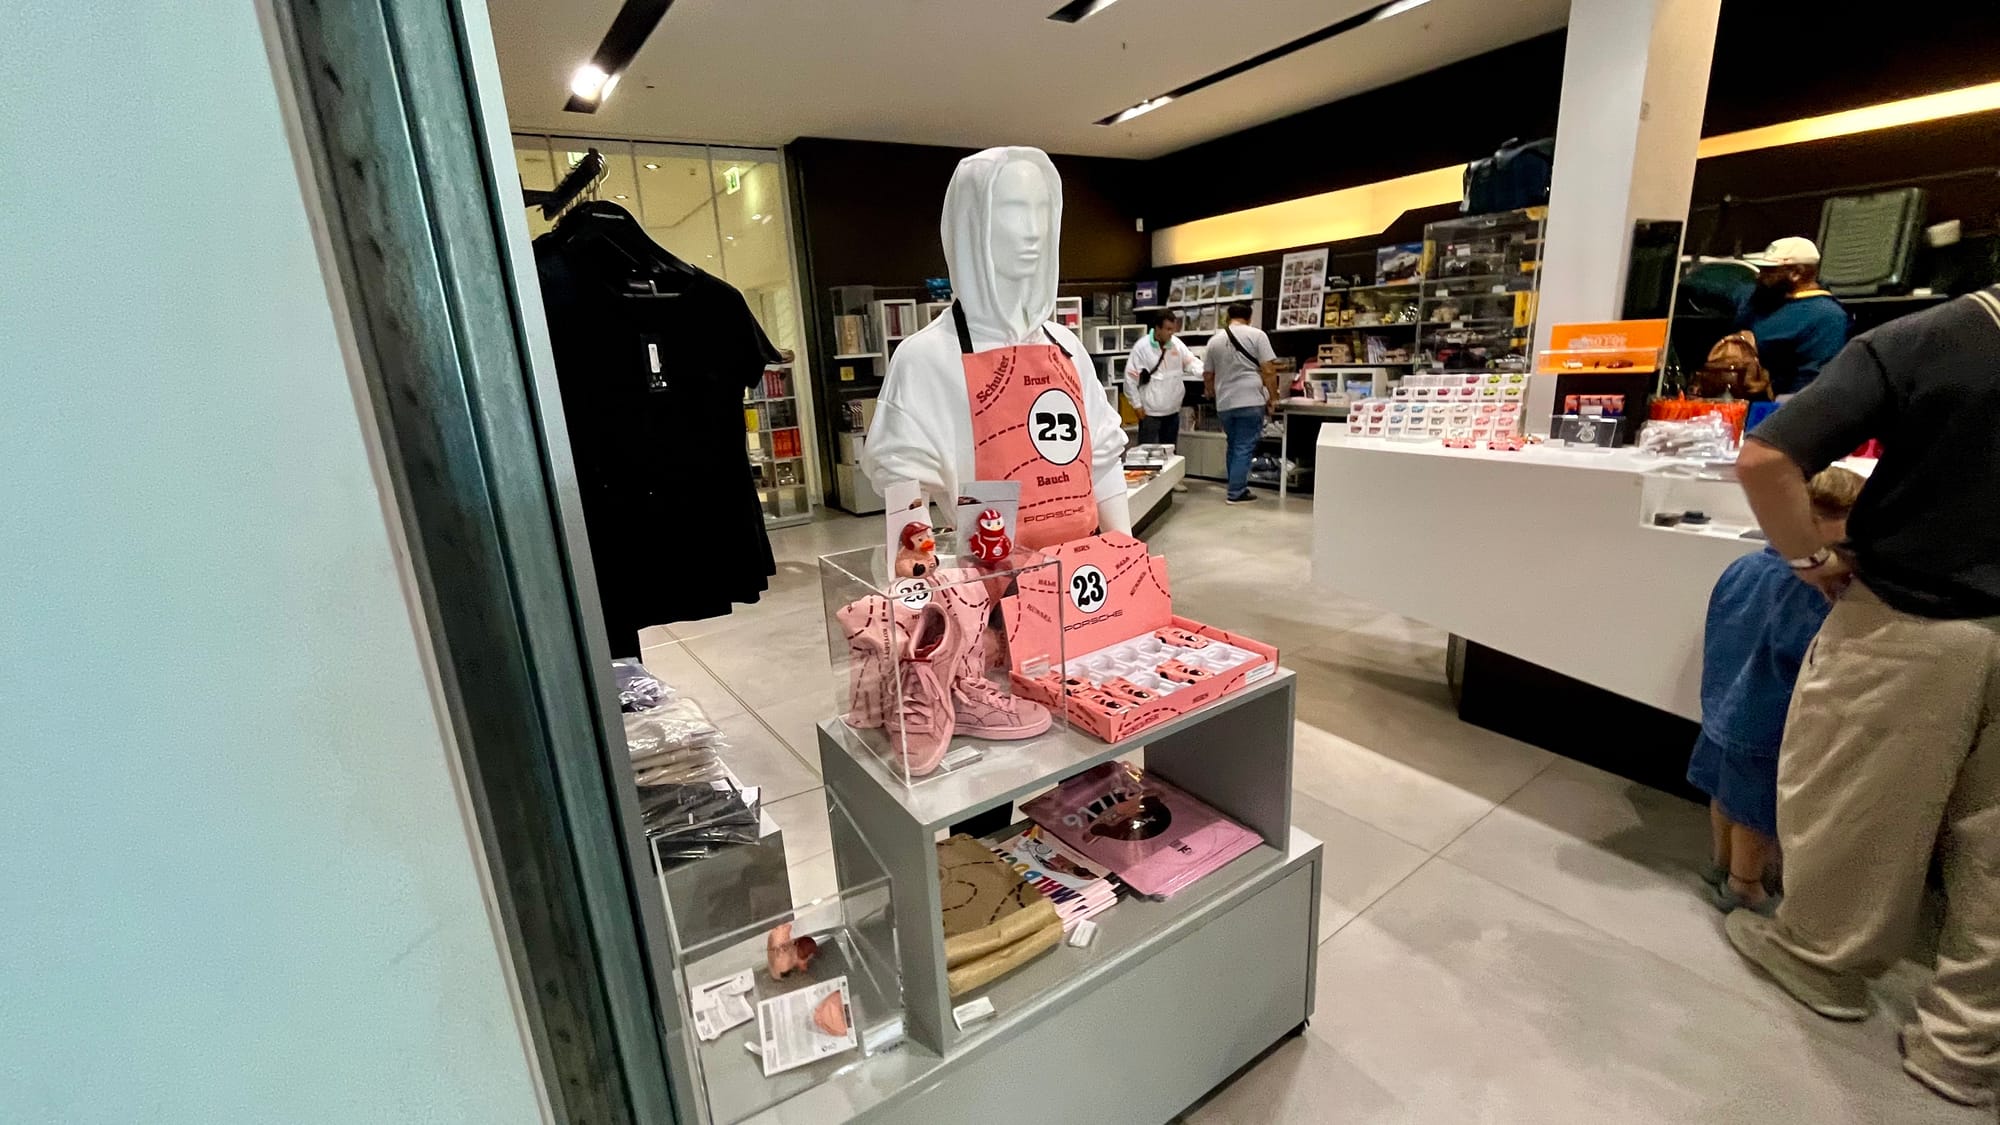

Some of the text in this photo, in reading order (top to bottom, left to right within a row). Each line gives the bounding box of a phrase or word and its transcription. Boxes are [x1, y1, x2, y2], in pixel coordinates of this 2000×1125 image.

[976, 354, 1010, 402] Schulter
[1023, 375, 1050, 386] Brust
[1036, 412, 1077, 442] 23
[1037, 472, 1070, 487] Bauch
[1023, 506, 1085, 523] PORSCHE
[1073, 571, 1104, 607] 23
[1064, 609, 1124, 632] PORSCHE
